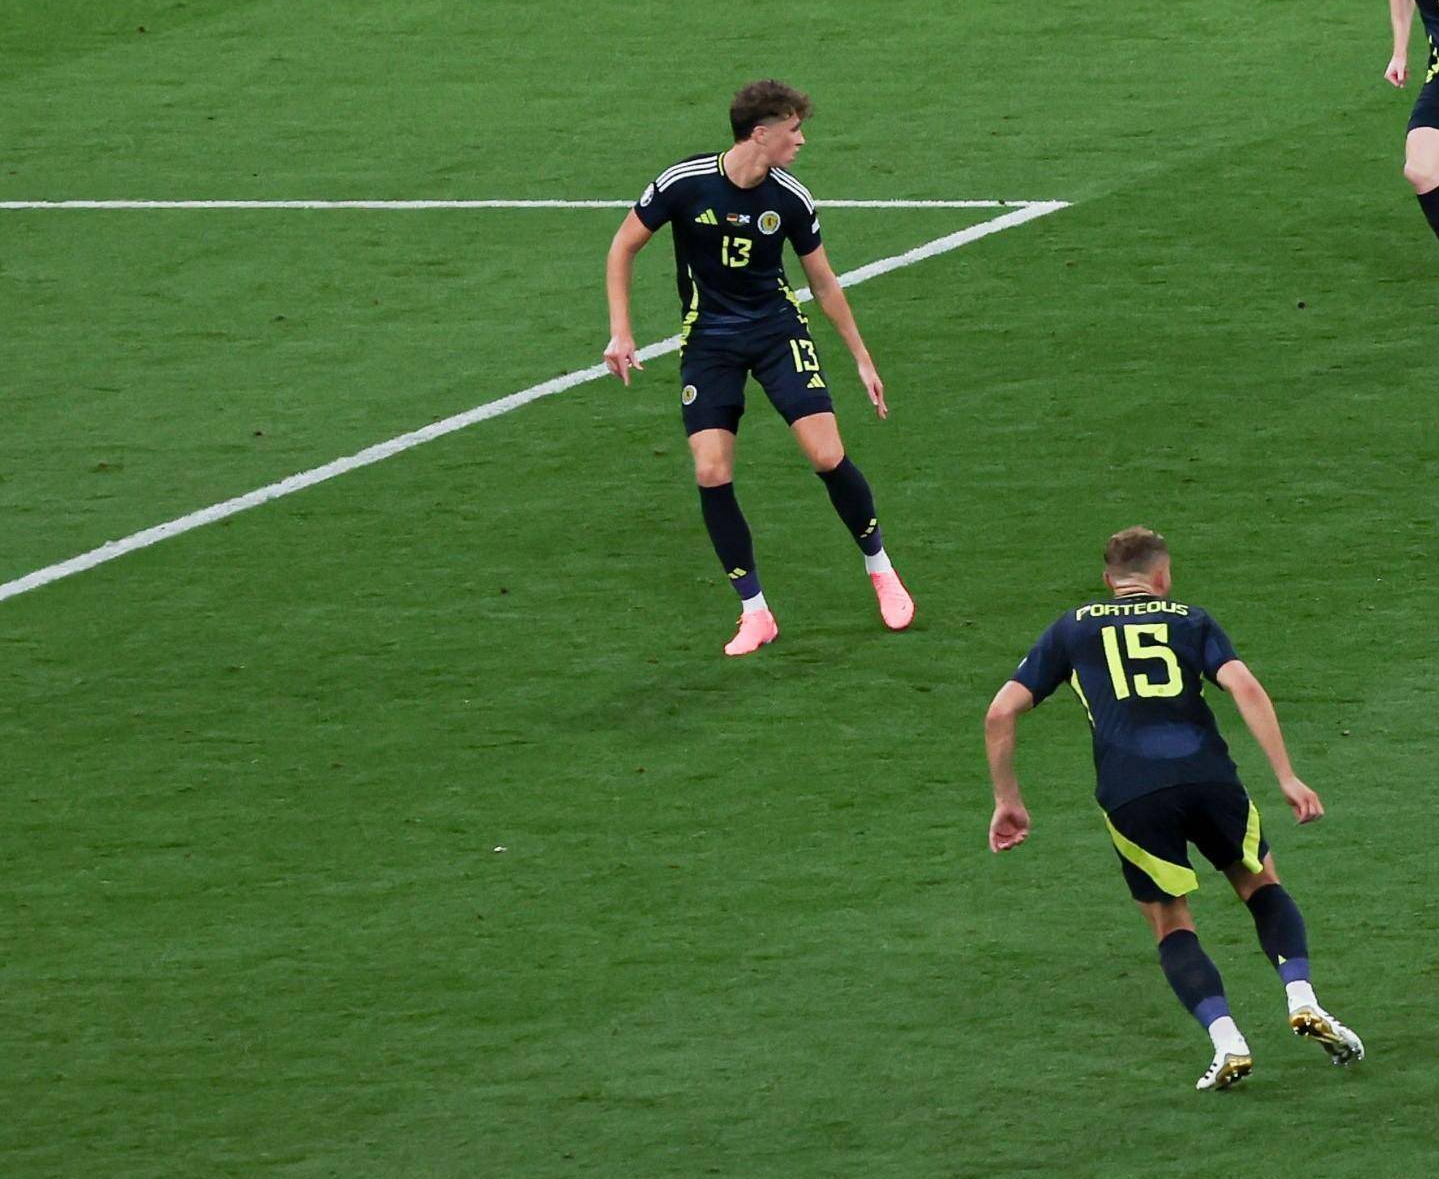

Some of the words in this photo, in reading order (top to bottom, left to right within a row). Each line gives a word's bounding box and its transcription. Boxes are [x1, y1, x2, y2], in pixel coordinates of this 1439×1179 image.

[721, 236, 752, 268] 13
[789, 339, 820, 373] 13
[1075, 602, 1190, 622] PORTEOUS
[1101, 622, 1184, 701] 15
